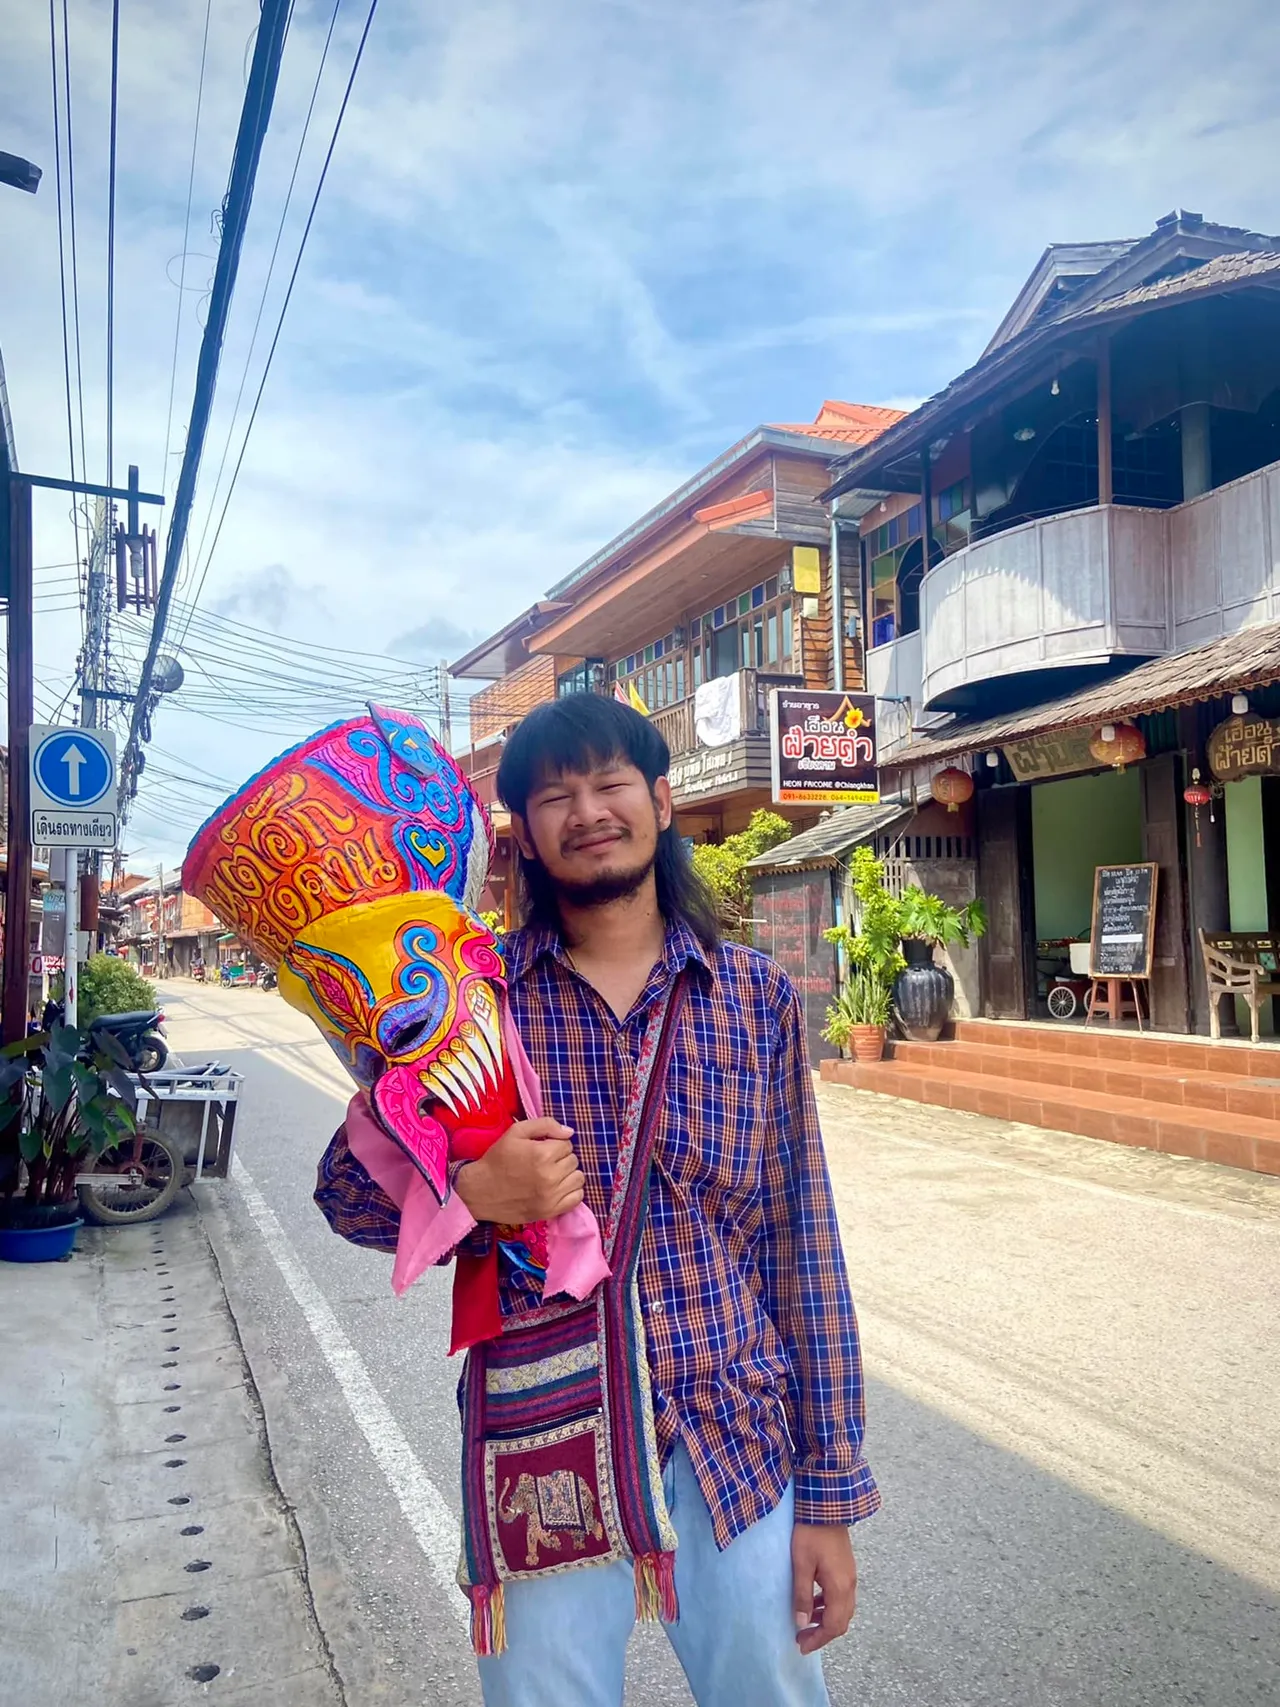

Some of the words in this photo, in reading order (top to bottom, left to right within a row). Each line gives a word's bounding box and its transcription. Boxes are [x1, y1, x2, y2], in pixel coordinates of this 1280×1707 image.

[782, 725, 874, 767] ฝ้ายคำ
[783, 780, 802, 788] HEON
[36, 816, 113, 838] เดินรถทางเดียว
